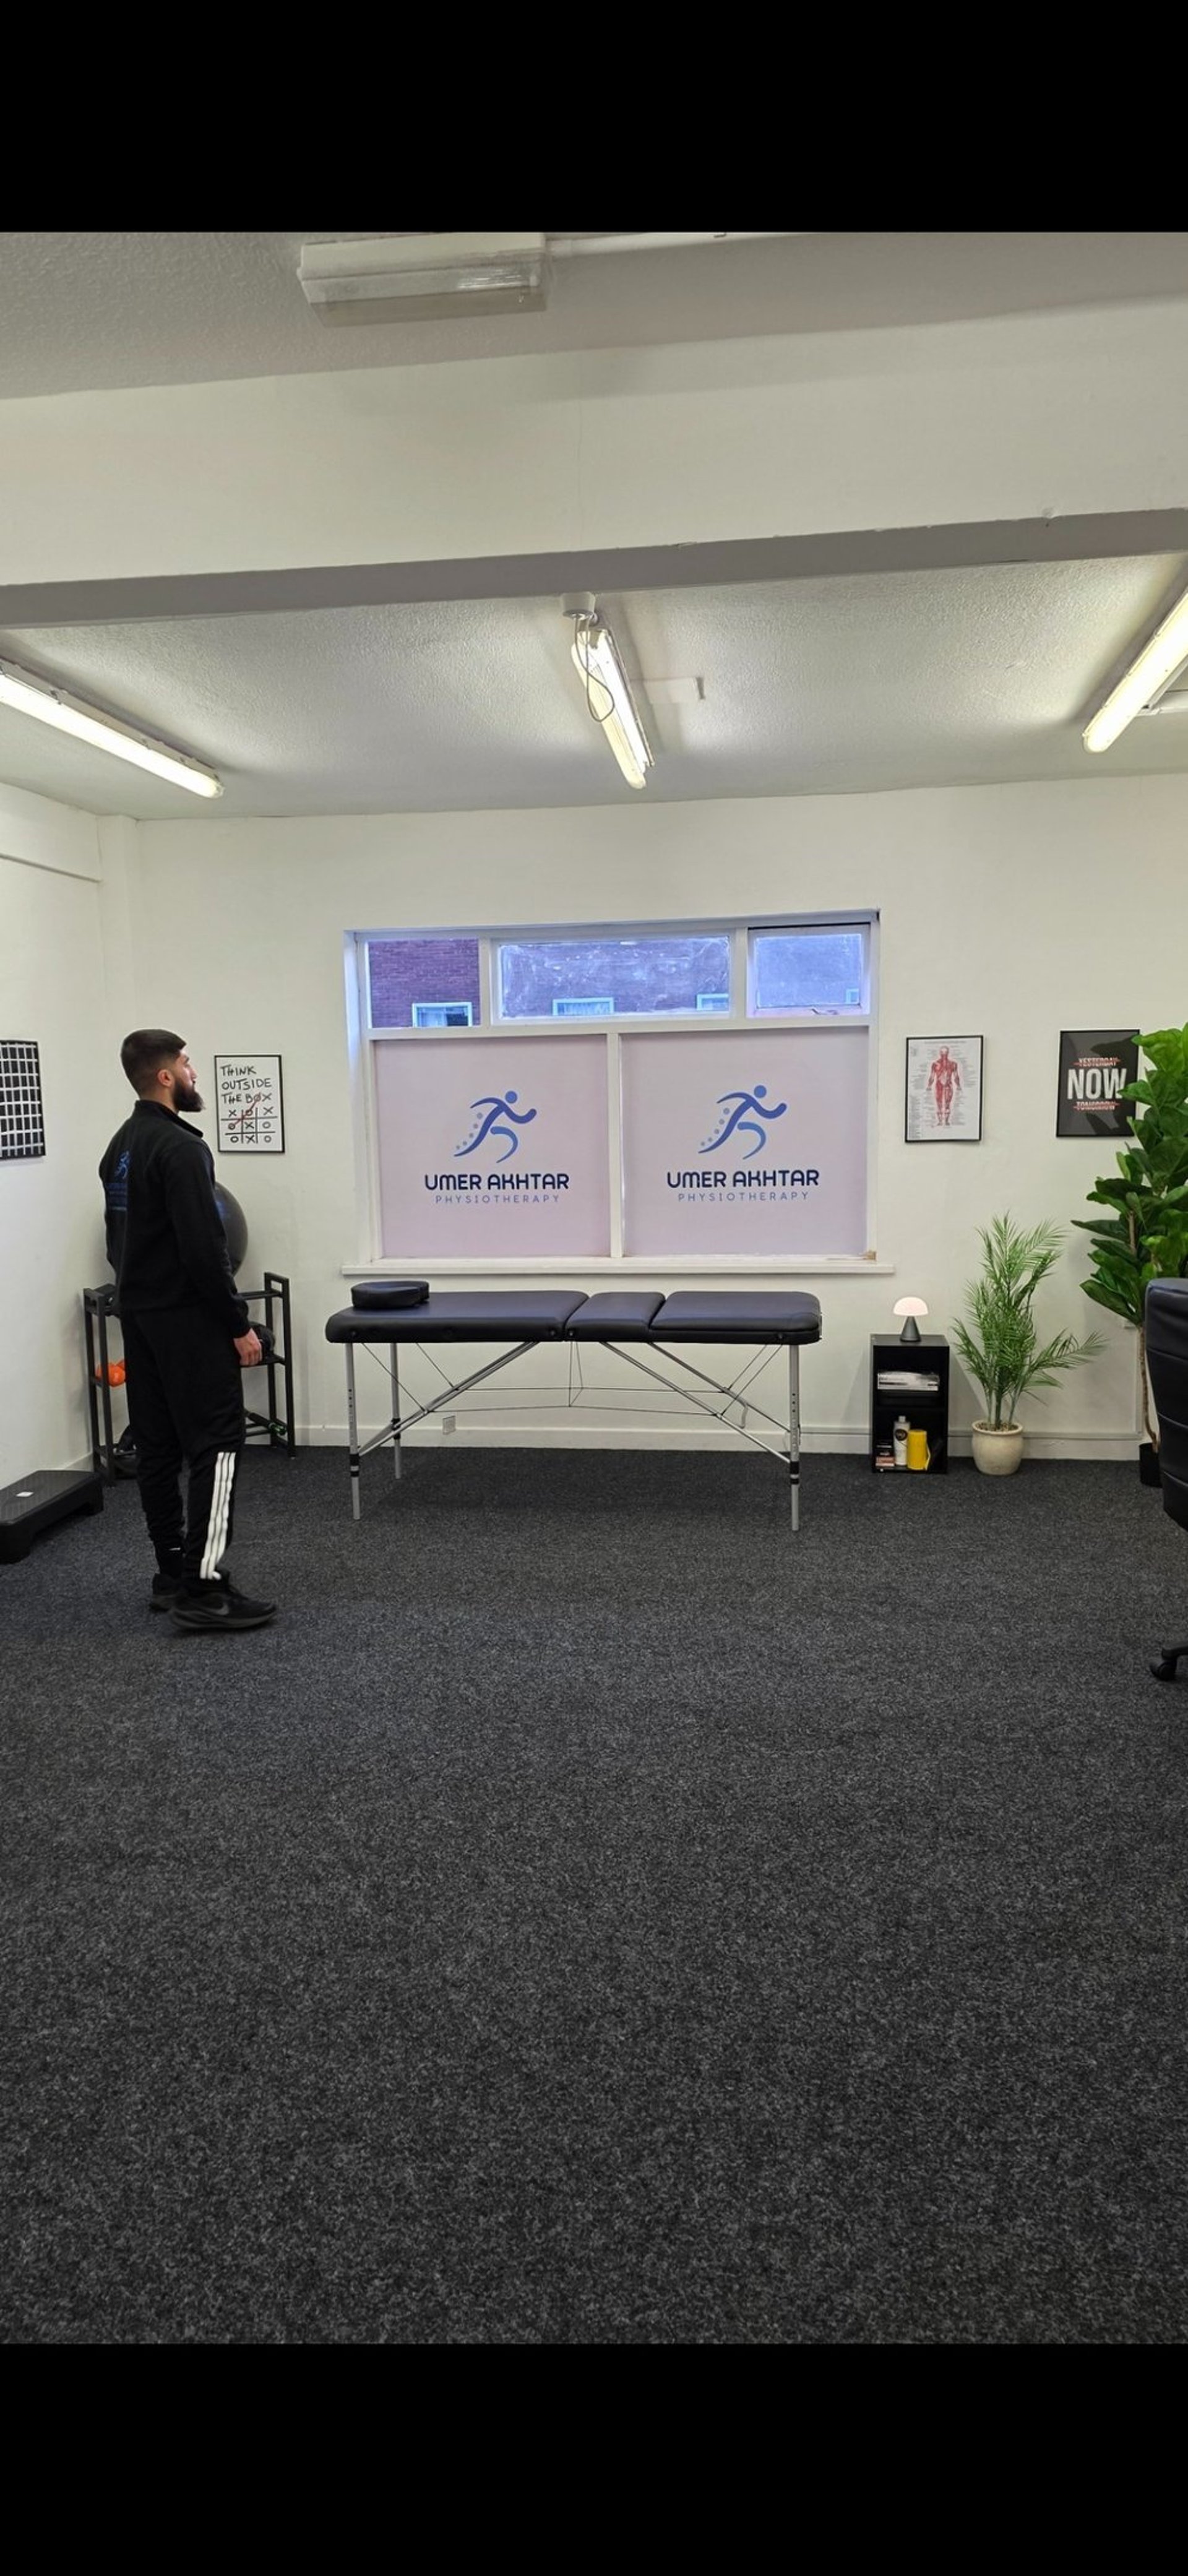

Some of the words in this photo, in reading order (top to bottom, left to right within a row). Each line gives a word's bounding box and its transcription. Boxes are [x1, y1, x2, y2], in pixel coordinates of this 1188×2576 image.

[220, 1064, 257, 1075] THINK
[222, 1078, 272, 1090] OUTSIDE
[1067, 1068, 1127, 1100] NOW
[222, 1092, 243, 1105] THE
[246, 1092, 272, 1104] BOX
[424, 1174, 482, 1191] UMER
[488, 1173, 570, 1190] AKHTAR
[666, 1171, 727, 1189] UMER
[733, 1170, 820, 1187] AKHTAR
[436, 1195, 560, 1204] PHYSIOTHERAPY
[678, 1192, 809, 1202] PHYSIOTHERAPY
